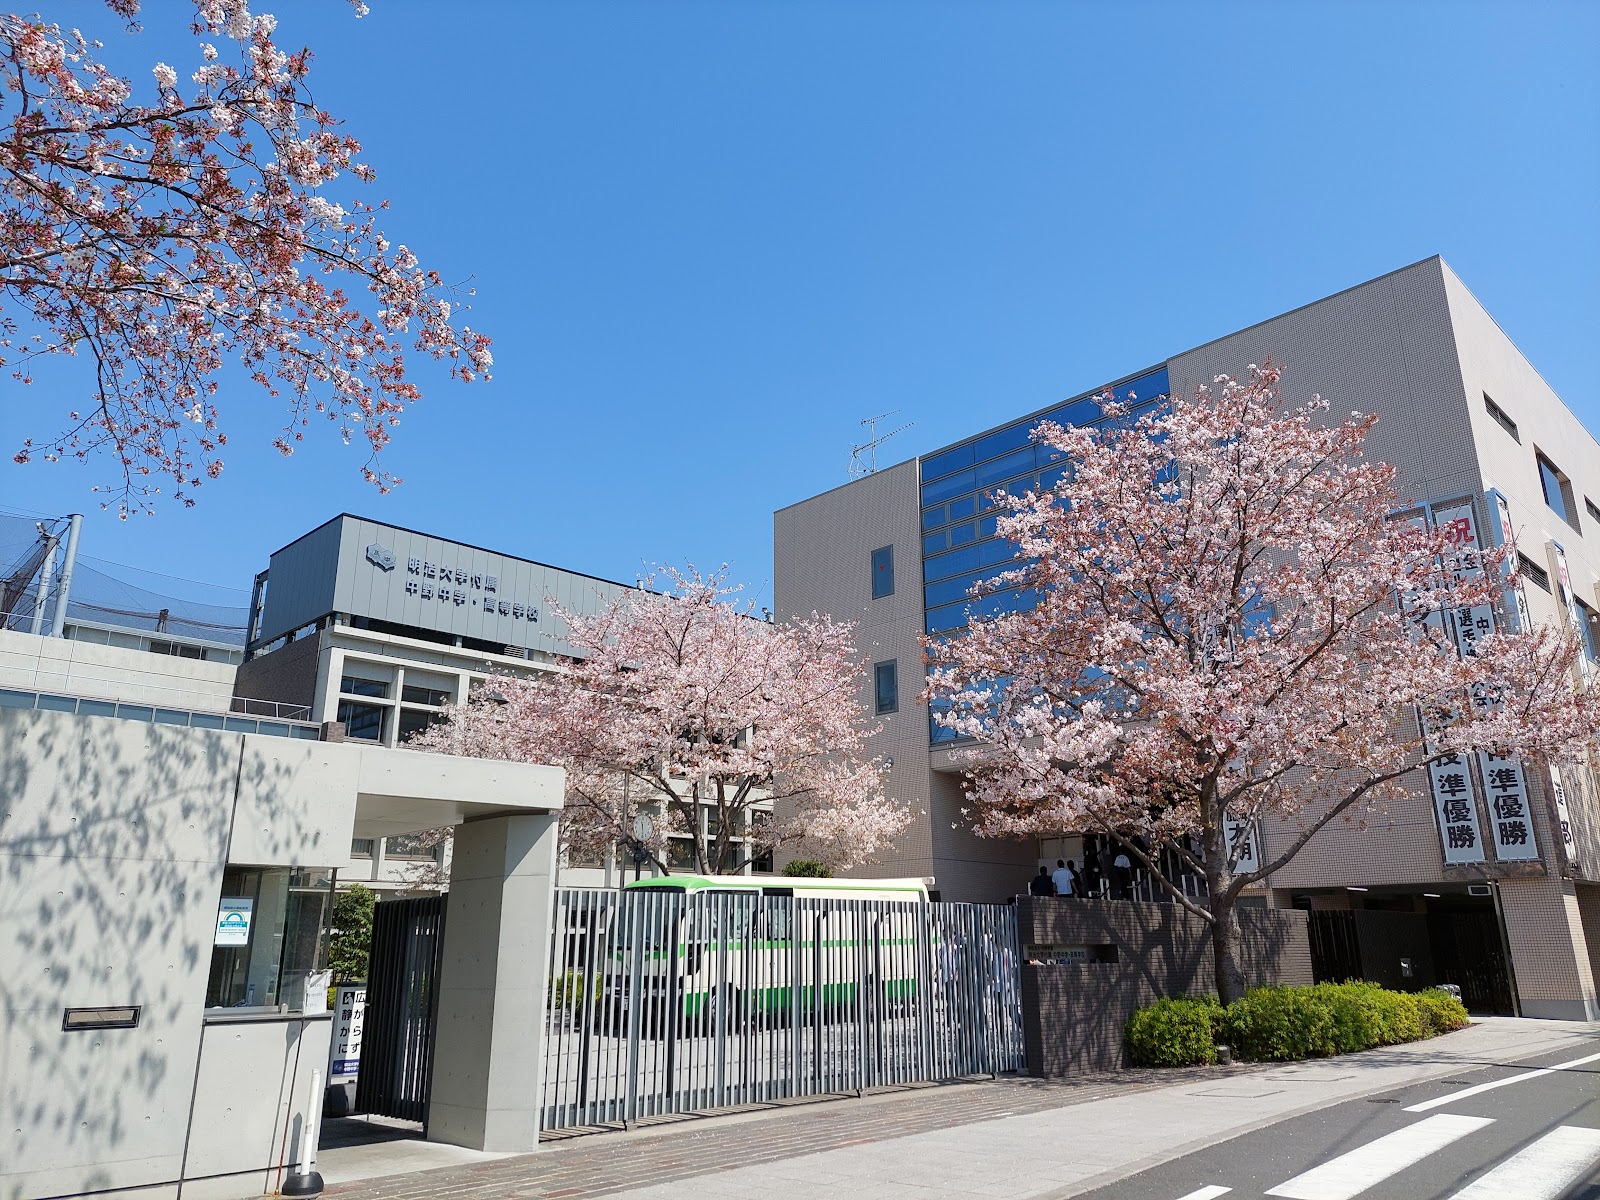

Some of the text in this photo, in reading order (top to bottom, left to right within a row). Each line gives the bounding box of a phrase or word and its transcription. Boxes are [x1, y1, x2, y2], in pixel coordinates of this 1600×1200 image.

[1488, 752, 1528, 846] 準優勝
[338, 1009, 353, 1054] 静かに
[350, 992, 367, 1054] 広がらず
